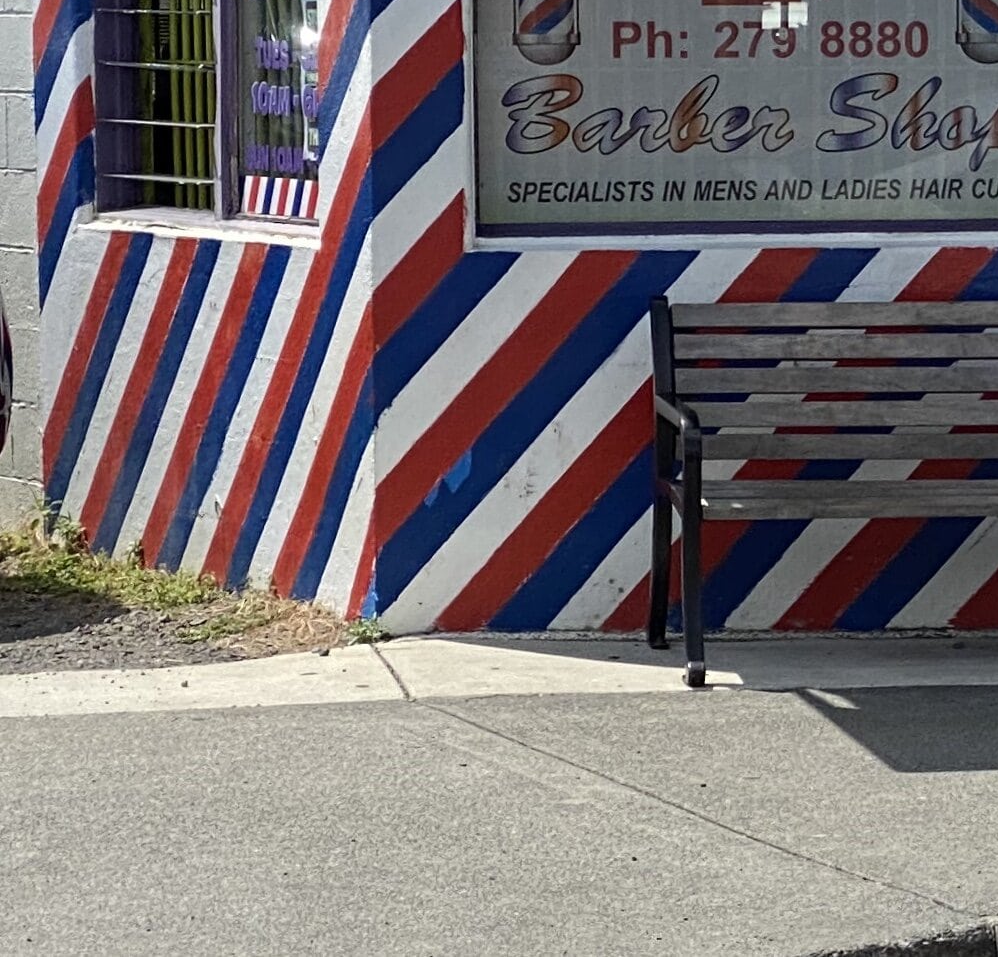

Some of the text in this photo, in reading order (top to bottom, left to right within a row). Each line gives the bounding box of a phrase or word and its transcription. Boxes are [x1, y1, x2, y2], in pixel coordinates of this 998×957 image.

[612, 20, 929, 59] Ph: 279 8880
[501, 73, 794, 155] Barber
[507, 181, 655, 203] SPECIALISTS
[662, 180, 686, 202] IN
[693, 179, 758, 202] MENS
[764, 179, 813, 201] AND
[820, 178, 902, 201] LADIES
[909, 178, 963, 201] HAIR
